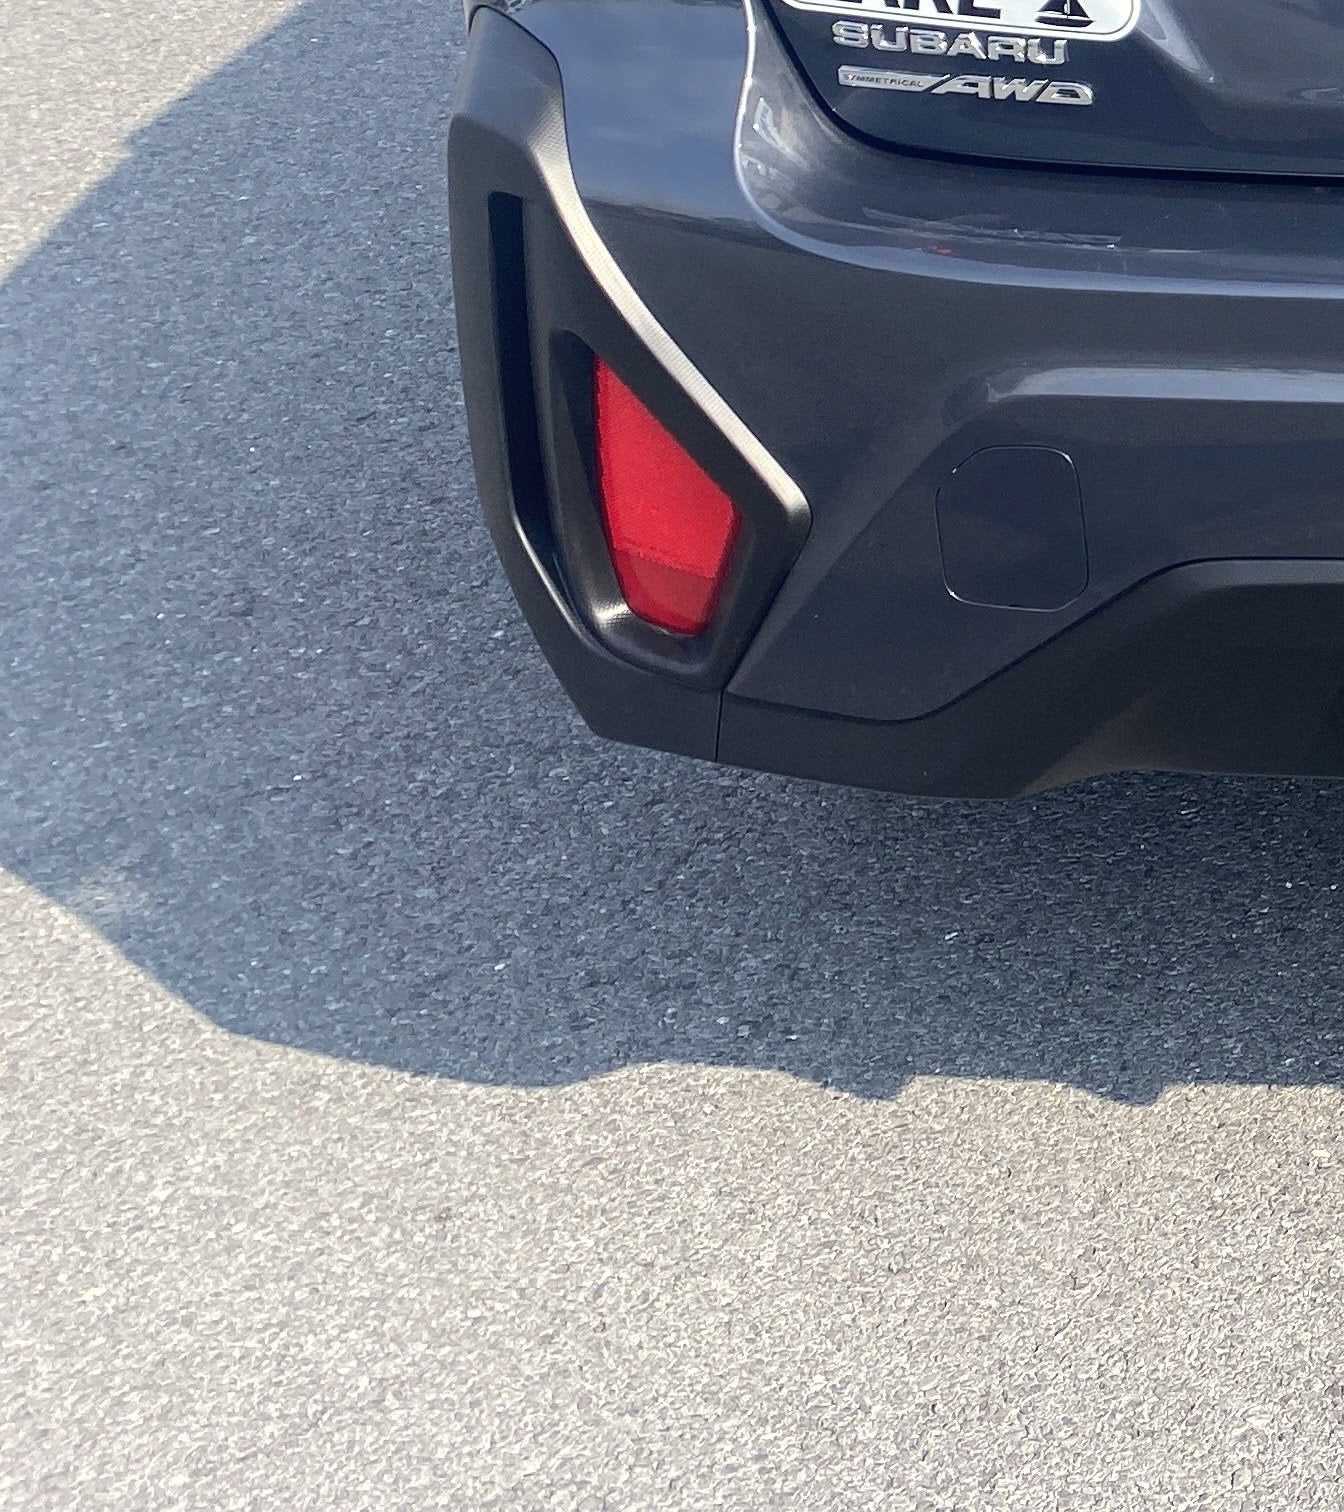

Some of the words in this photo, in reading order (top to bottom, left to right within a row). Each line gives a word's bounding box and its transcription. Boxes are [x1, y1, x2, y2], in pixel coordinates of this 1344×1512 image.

[831, 20, 1070, 65] SUBARU
[843, 72, 927, 89] SYMMETRICAL
[931, 75, 1095, 106] AWD
